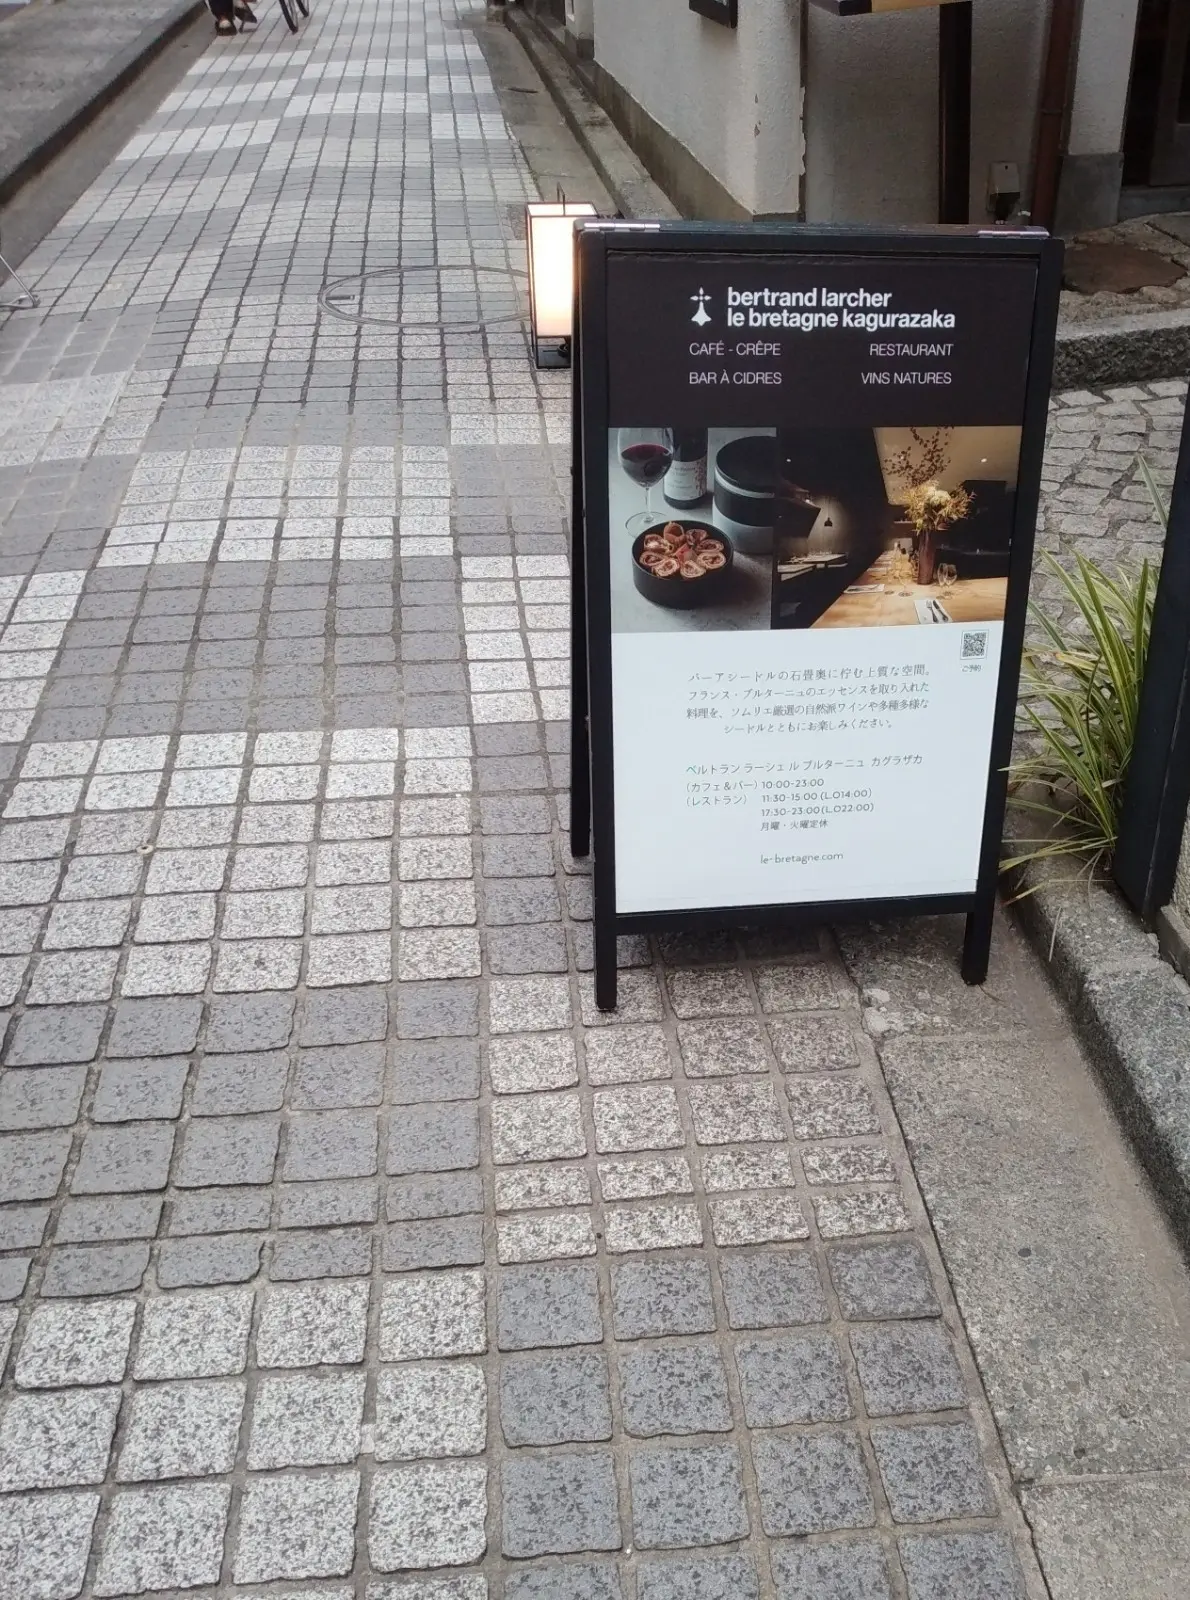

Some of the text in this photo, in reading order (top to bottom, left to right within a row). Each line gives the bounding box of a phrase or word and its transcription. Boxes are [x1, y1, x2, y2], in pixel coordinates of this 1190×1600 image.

[728, 287, 892, 308] bertrand larcher
[727, 308, 956, 332] le bretagne kagurazaka
[689, 340, 725, 356] CAFÉ
[736, 341, 781, 356] CRÊPE
[869, 343, 954, 357] RESTAURANT
[689, 368, 782, 385] BAR À CIDRES
[860, 371, 952, 385] VINS NATURES
[723, 718, 893, 734] シードルとともにお楽しみください。
[871, 754, 923, 767] カグラザカ
[762, 778, 825, 789] 10:00-23:00
[760, 852, 844, 865] le-bretagne.com
